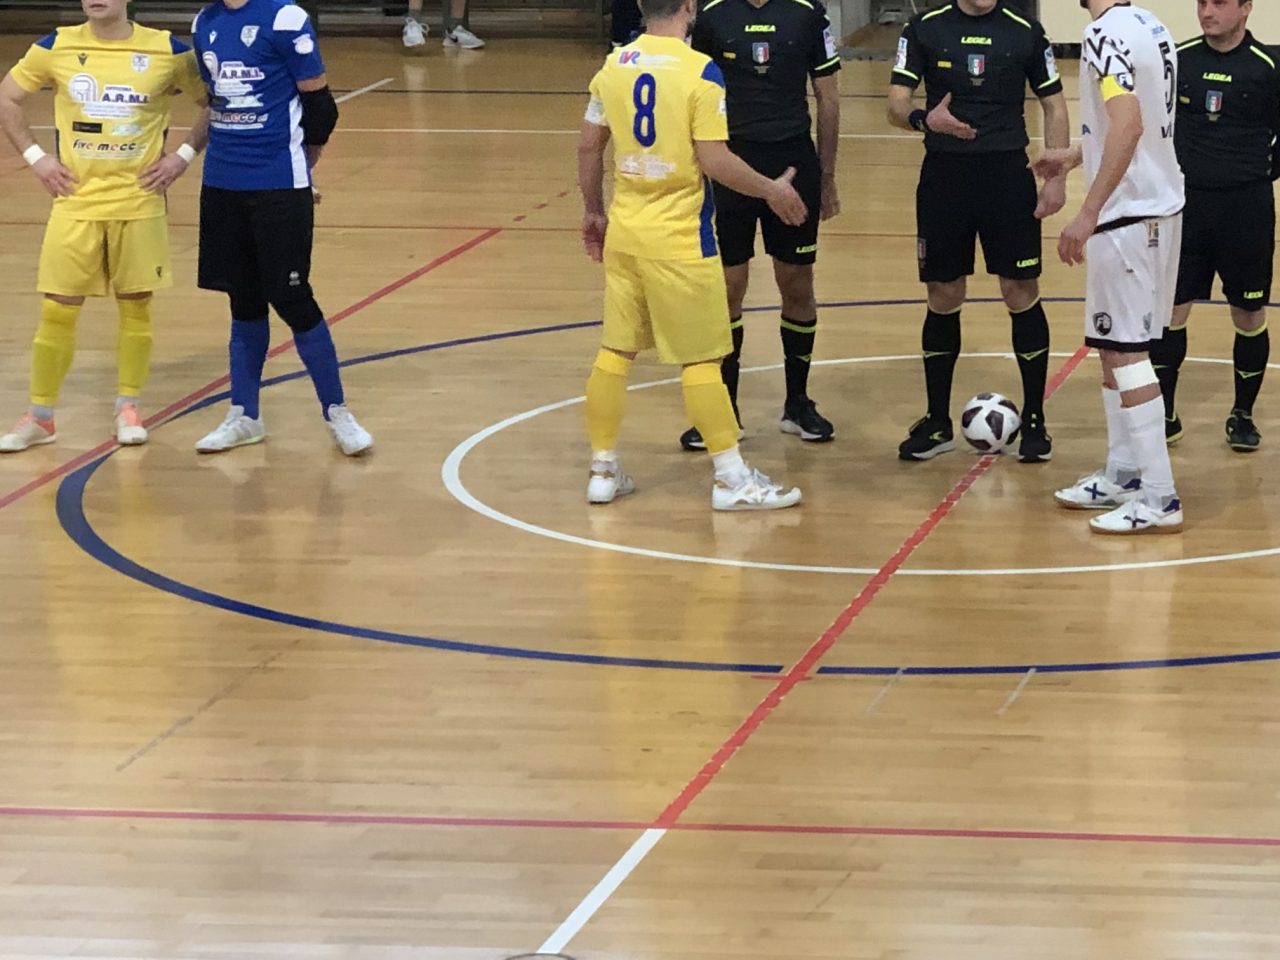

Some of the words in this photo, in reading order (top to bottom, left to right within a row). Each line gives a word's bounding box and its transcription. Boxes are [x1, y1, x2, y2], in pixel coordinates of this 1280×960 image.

[744, 24, 777, 32] LEGEA
[961, 36, 993, 45] LEGEA
[1158, 41, 1175, 114] 5
[1202, 72, 1232, 82] LEGEA
[633, 73, 656, 147] 8
